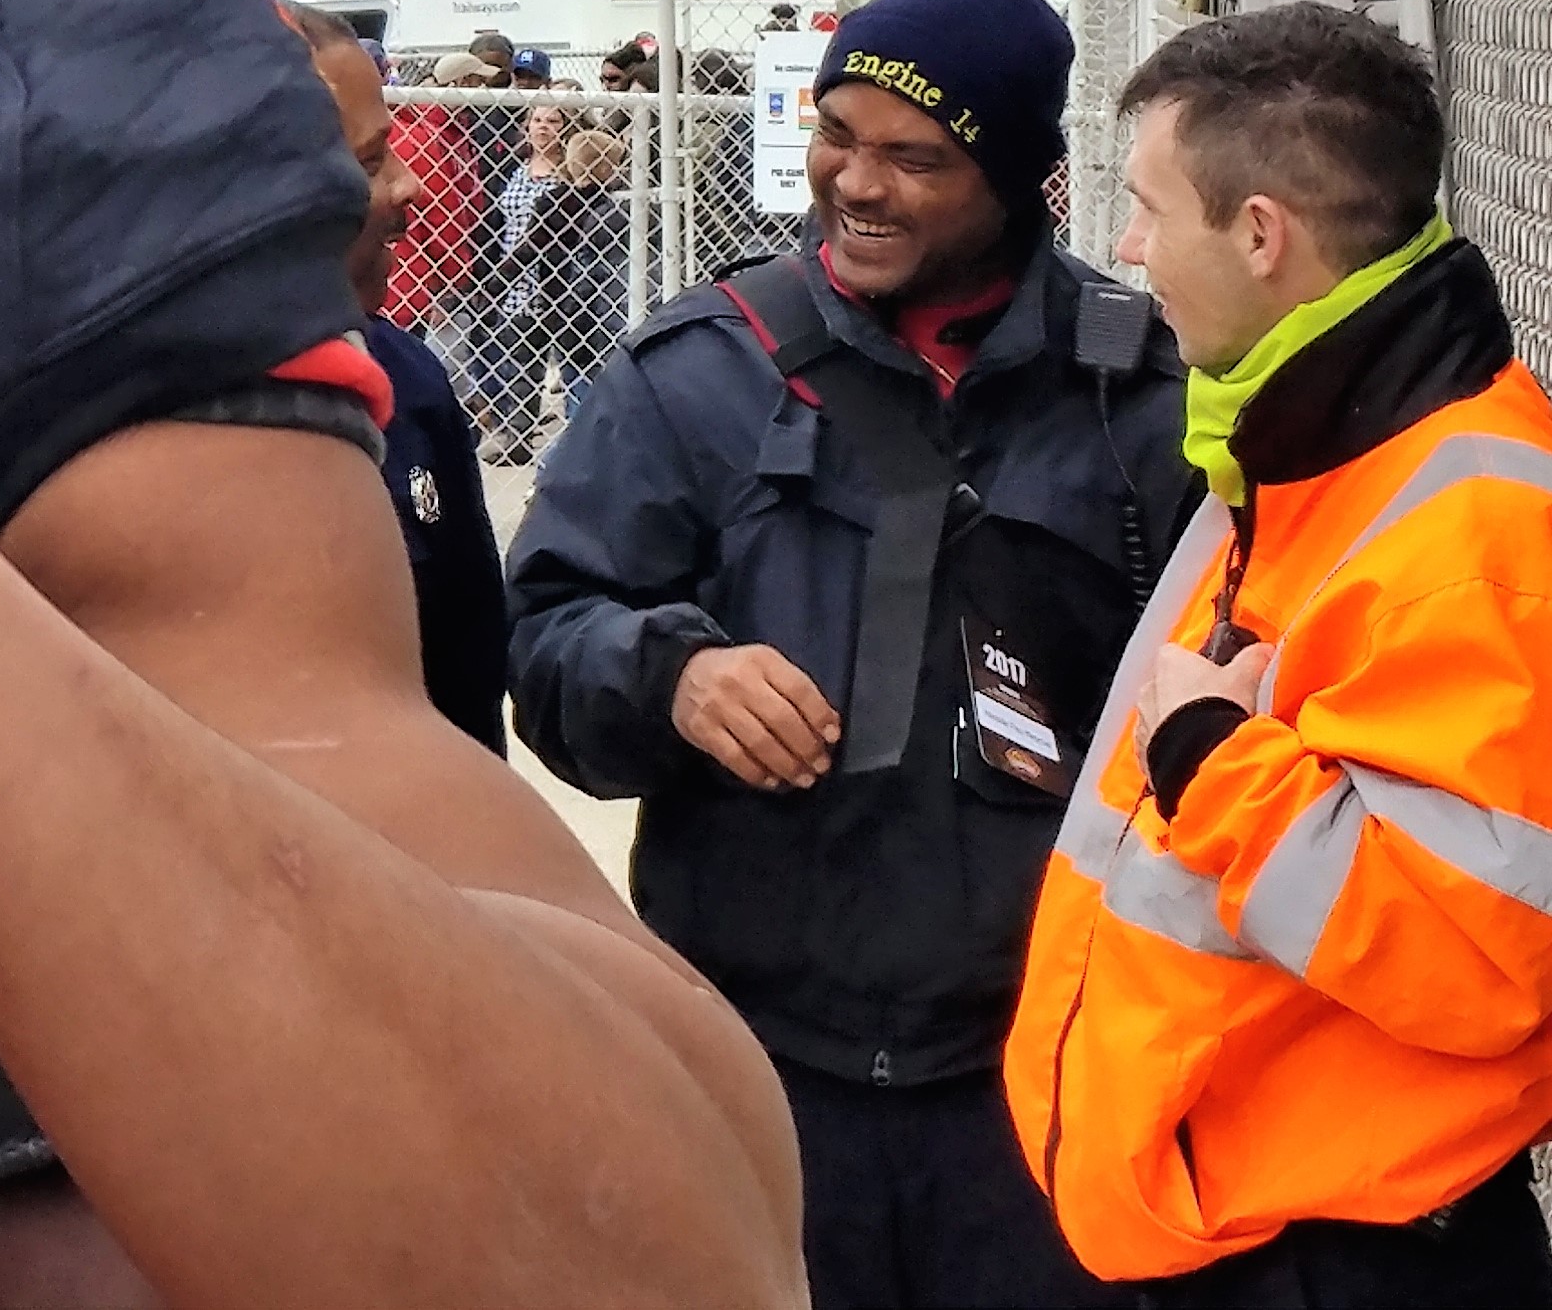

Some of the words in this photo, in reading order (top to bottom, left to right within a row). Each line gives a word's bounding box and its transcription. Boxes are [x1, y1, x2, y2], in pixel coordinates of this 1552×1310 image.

[843, 50, 943, 107] Engine
[949, 107, 981, 143] 14
[982, 642, 1027, 688] 2017
